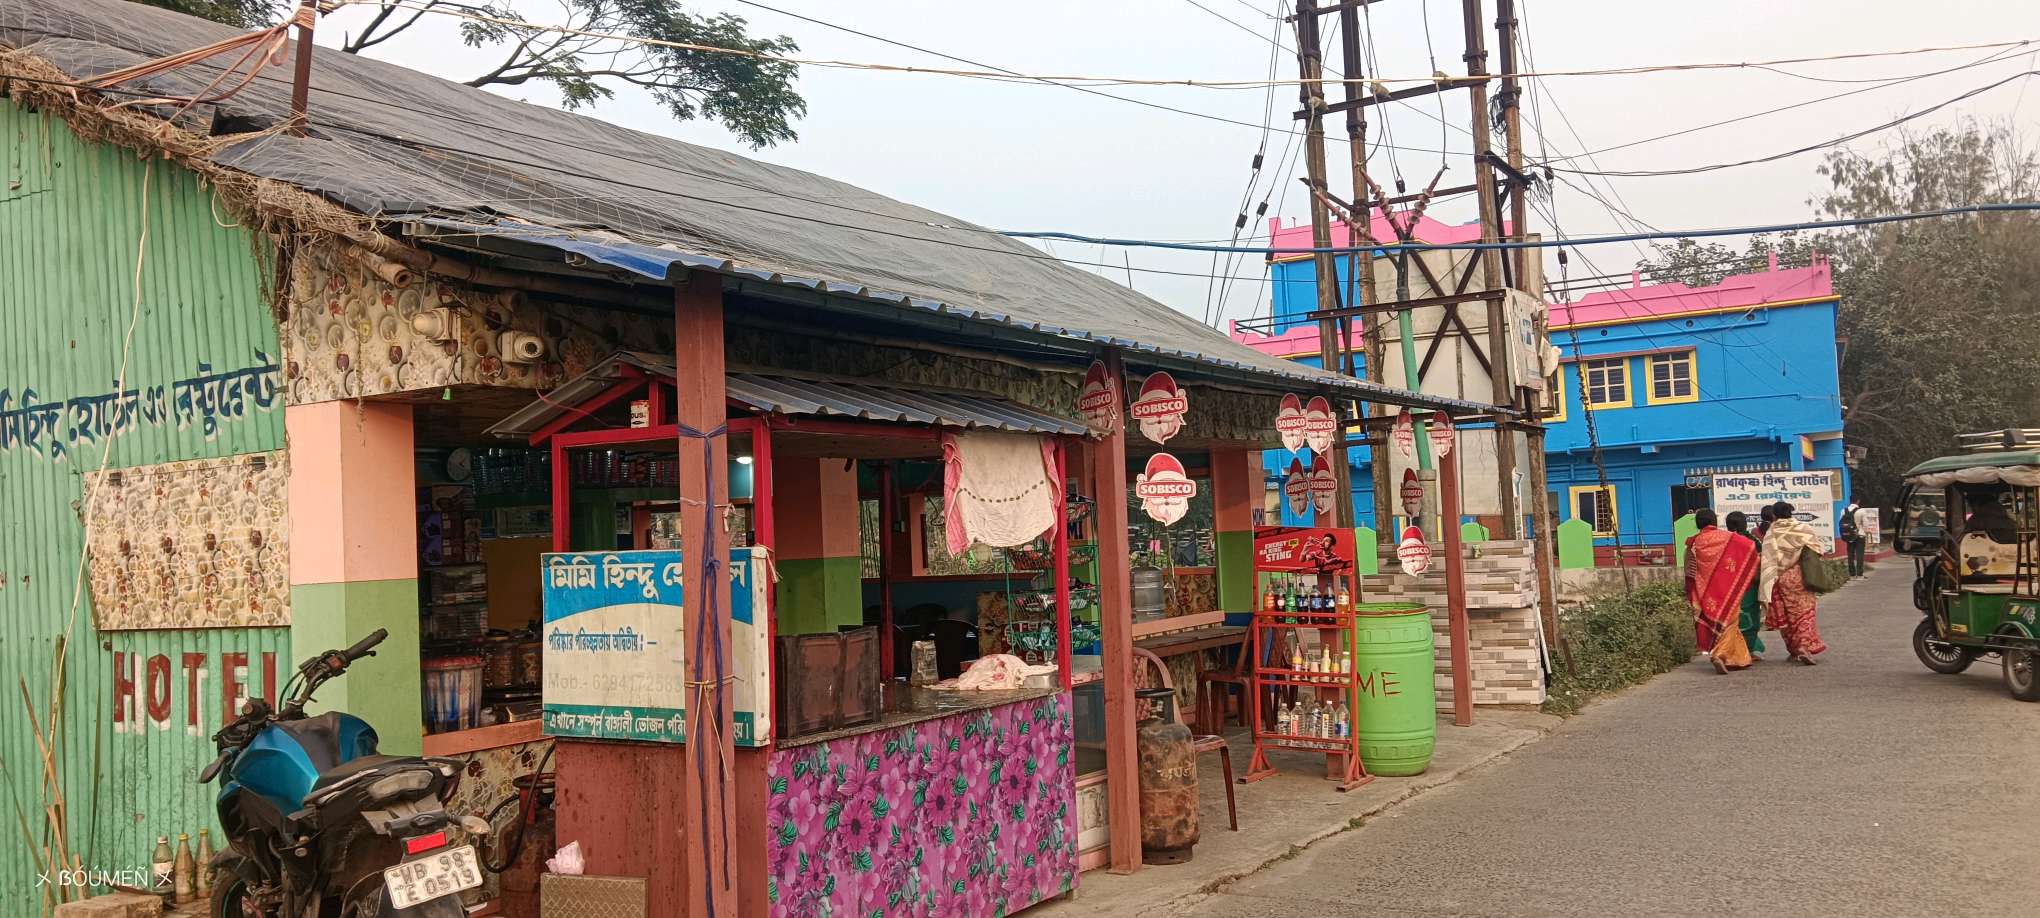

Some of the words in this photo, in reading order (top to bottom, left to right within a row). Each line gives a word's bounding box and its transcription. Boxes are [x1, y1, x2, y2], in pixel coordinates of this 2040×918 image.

[1081, 392, 1111, 410] SOBISCO
[1135, 400, 1183, 416] SOBISCO
[1278, 418, 1305, 429] SOBISCO
[1140, 484, 1192, 495] SOBISCO
[1310, 481, 1335, 489] SOBISCO
[1763, 474, 1787, 491] হিন্দু
[1792, 474, 1829, 487] হোটেল
[1265, 551, 1292, 563] STING
[1400, 547, 1429, 556] SOBISCO
[550, 555, 596, 590] মিমি
[602, 555, 660, 601] হিন্দু
[400, 863, 427, 885] WB
[424, 868, 475, 895] 0519
